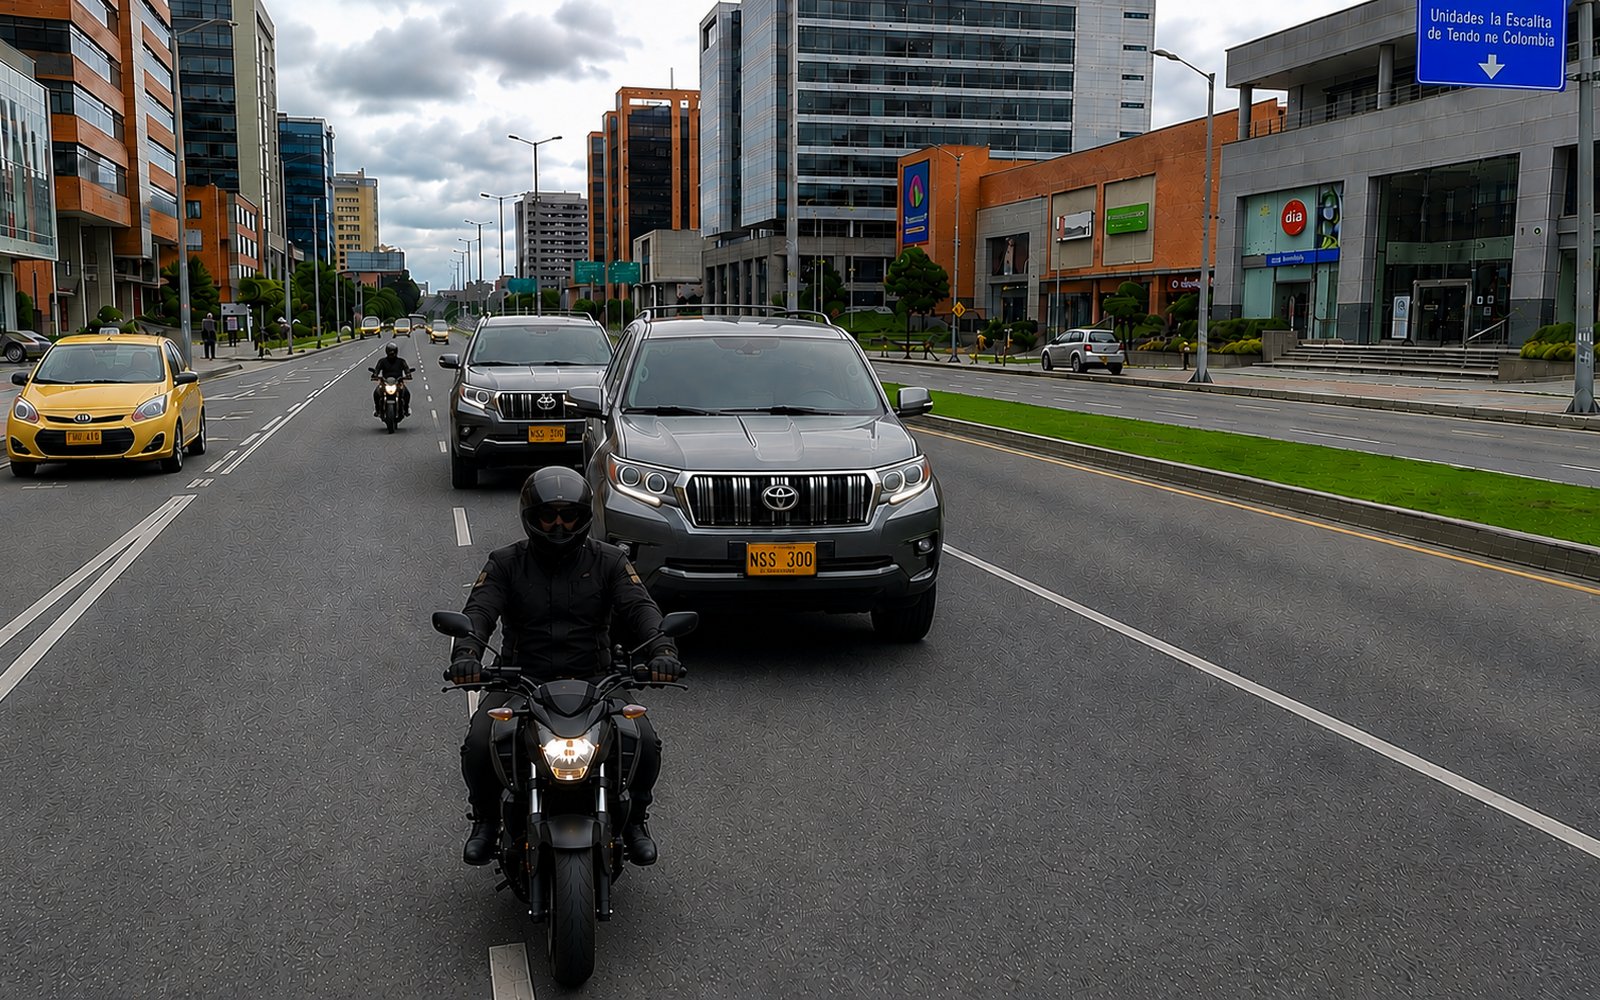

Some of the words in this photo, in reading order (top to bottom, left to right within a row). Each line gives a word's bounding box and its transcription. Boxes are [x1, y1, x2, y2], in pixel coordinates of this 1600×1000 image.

[1431, 8, 1484, 25] Unidades
[1490, 12, 1501, 26] la
[1428, 26, 1442, 40] de
[1447, 27, 1480, 43] Tendo
[1485, 33, 1499, 44] ne
[1503, 30, 1555, 47] Colombia
[1285, 209, 1303, 223] dia
[750, 551, 777, 568] NSS
[787, 551, 813, 568] 300
